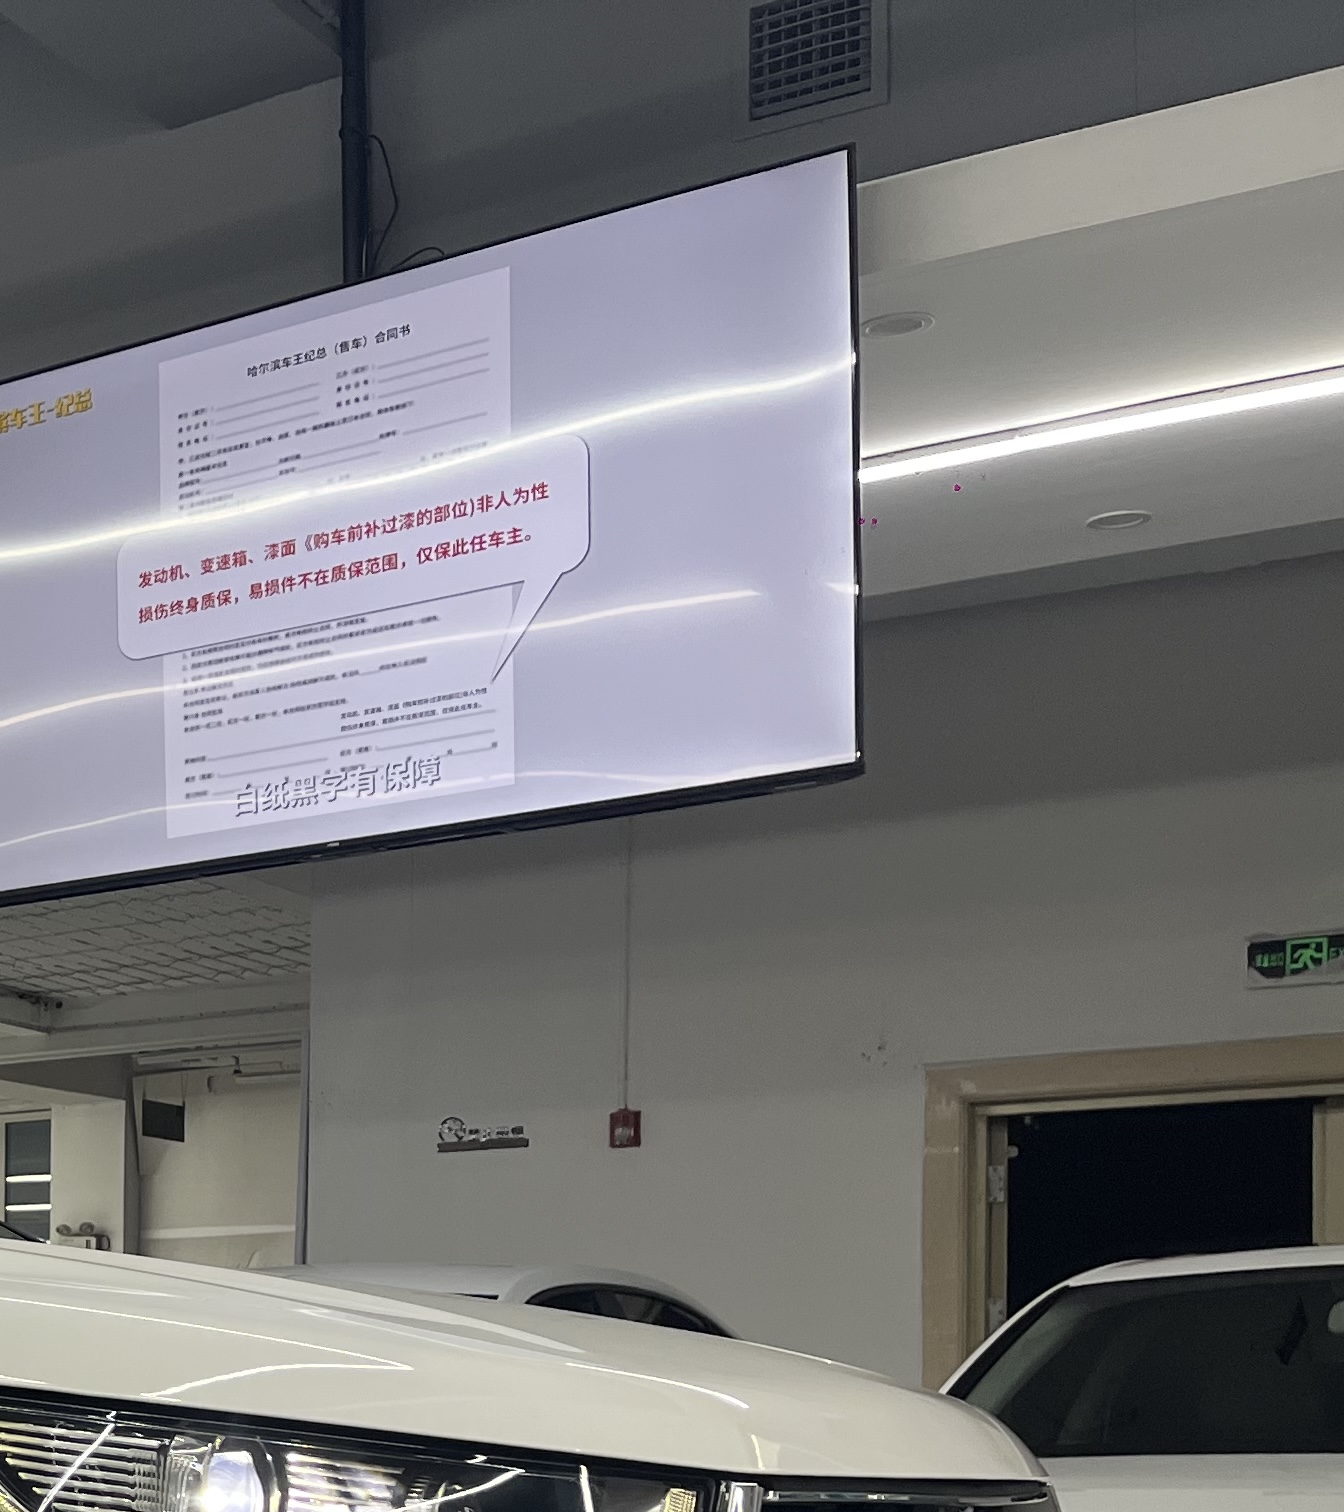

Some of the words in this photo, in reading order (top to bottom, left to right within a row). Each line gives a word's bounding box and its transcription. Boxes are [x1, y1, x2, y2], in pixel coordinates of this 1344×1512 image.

[235, 756, 442, 818] 白纸黑字有保障
